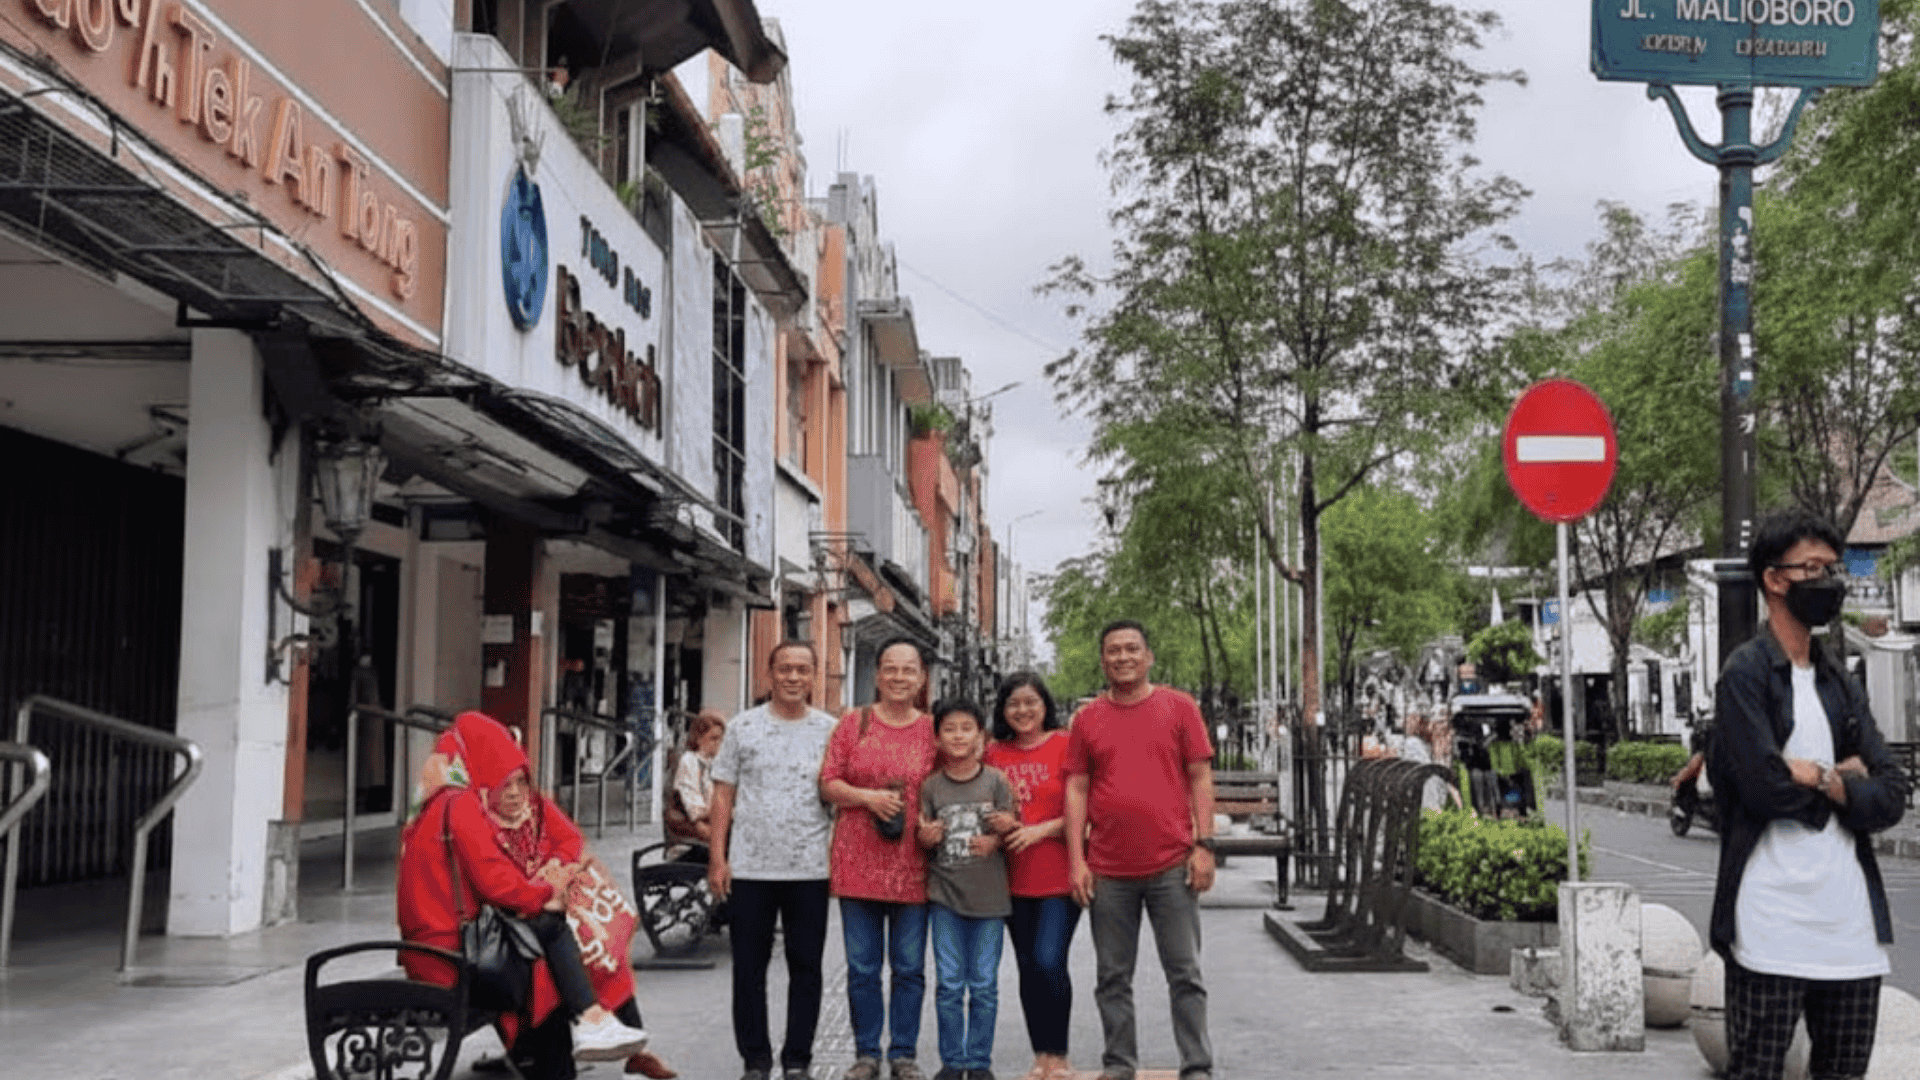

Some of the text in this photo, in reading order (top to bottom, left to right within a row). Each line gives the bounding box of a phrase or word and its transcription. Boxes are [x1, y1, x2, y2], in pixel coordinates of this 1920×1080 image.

[1677, 0, 1855, 26] MALIOBORO
[174, 6, 262, 168] Tek
[266, 98, 332, 218] An
[337, 144, 418, 300] Tong
